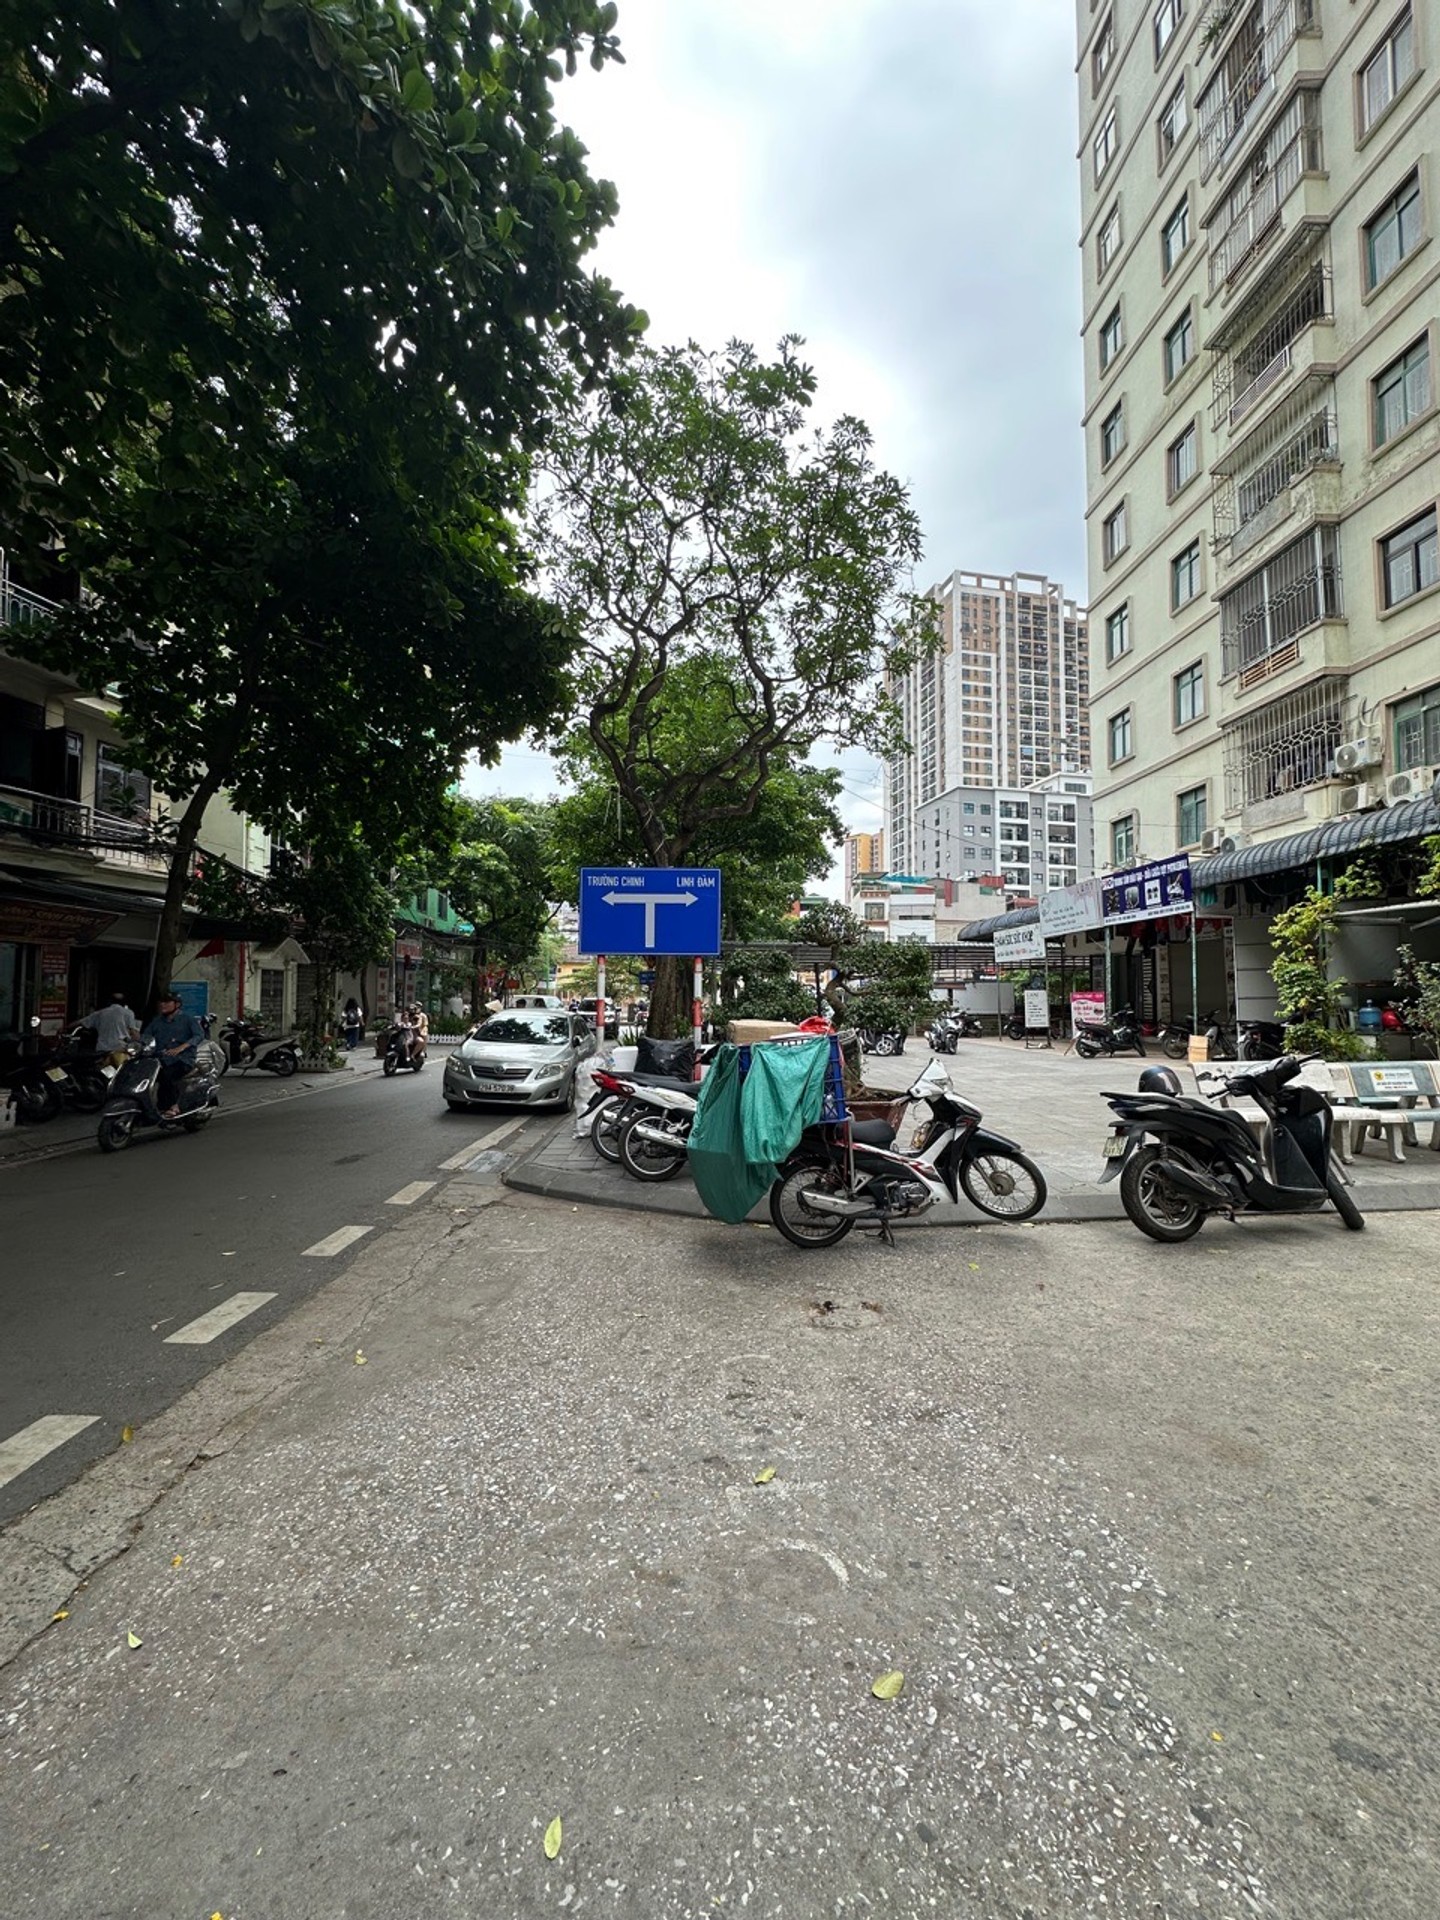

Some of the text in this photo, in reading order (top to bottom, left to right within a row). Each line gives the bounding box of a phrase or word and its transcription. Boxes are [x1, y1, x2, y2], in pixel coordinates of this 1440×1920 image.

[587, 873, 645, 887] TRƯỜNG CHINH
[676, 874, 716, 888] LINH ĐÀM
